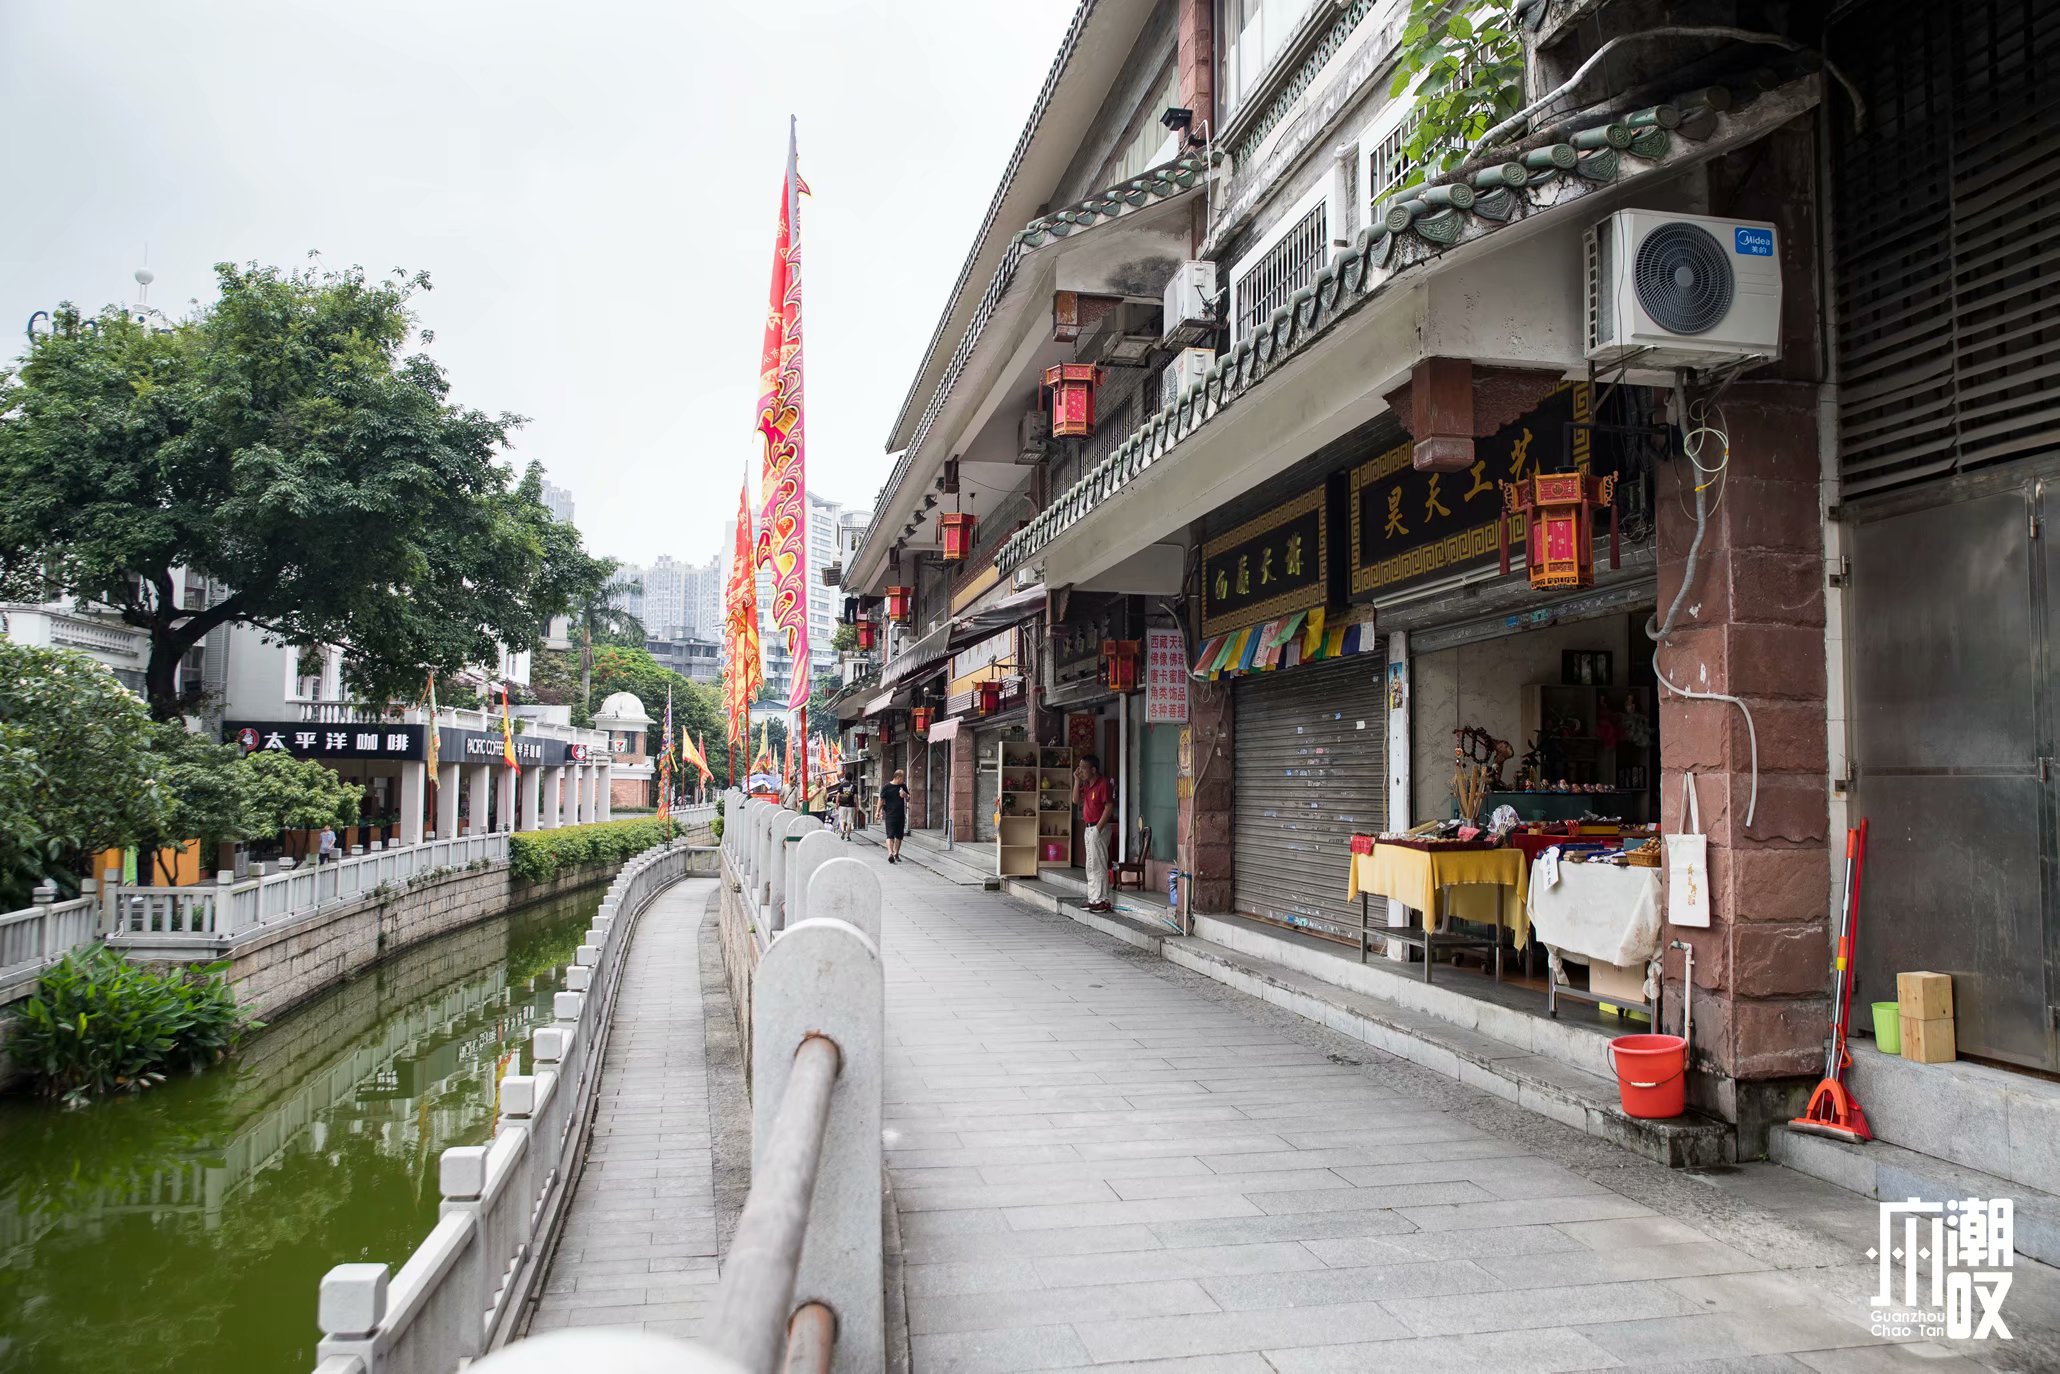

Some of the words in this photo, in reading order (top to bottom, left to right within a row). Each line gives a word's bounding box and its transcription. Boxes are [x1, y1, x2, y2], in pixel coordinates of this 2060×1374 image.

[1741, 234, 1771, 245] Midea
[1751, 246, 1767, 254] 美的
[264, 731, 409, 751] 太平洋咖啡
[467, 738, 486, 754] PACIFIC
